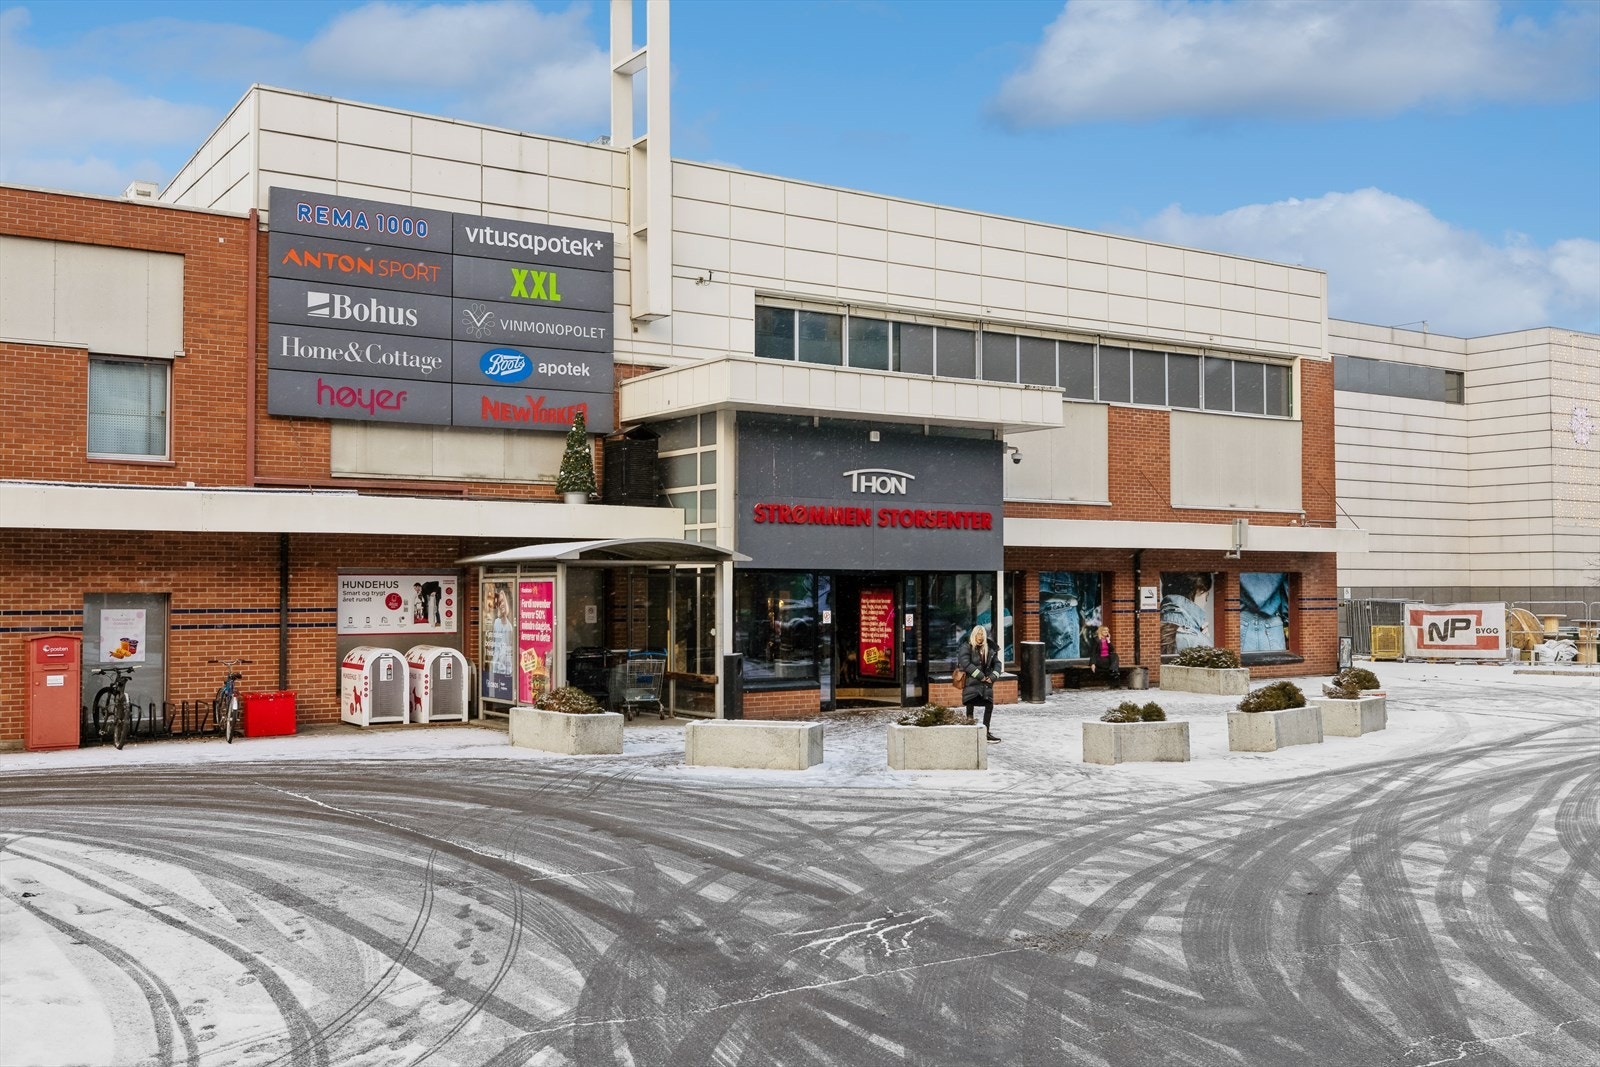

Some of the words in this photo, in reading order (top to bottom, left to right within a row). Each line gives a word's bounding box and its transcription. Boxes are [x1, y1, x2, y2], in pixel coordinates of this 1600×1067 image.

[297, 202, 369, 231] REMA
[376, 213, 429, 238] 1000
[282, 248, 374, 275] ANTON
[378, 259, 441, 282] SPORT
[510, 268, 561, 301] XXL
[331, 293, 418, 327] Bohus
[500, 319, 606, 339] VINMONOPOLET
[485, 353, 526, 376] Boots
[538, 361, 590, 377] apotek
[317, 377, 407, 416] høyer
[843, 468, 915, 495] THON
[753, 503, 872, 527] STRØMMEN
[877, 508, 993, 531] STORSENTER
[342, 580, 399, 589] HUNDEHUS
[1428, 618, 1471, 642] NP
[1475, 627, 1499, 635] BYGG
